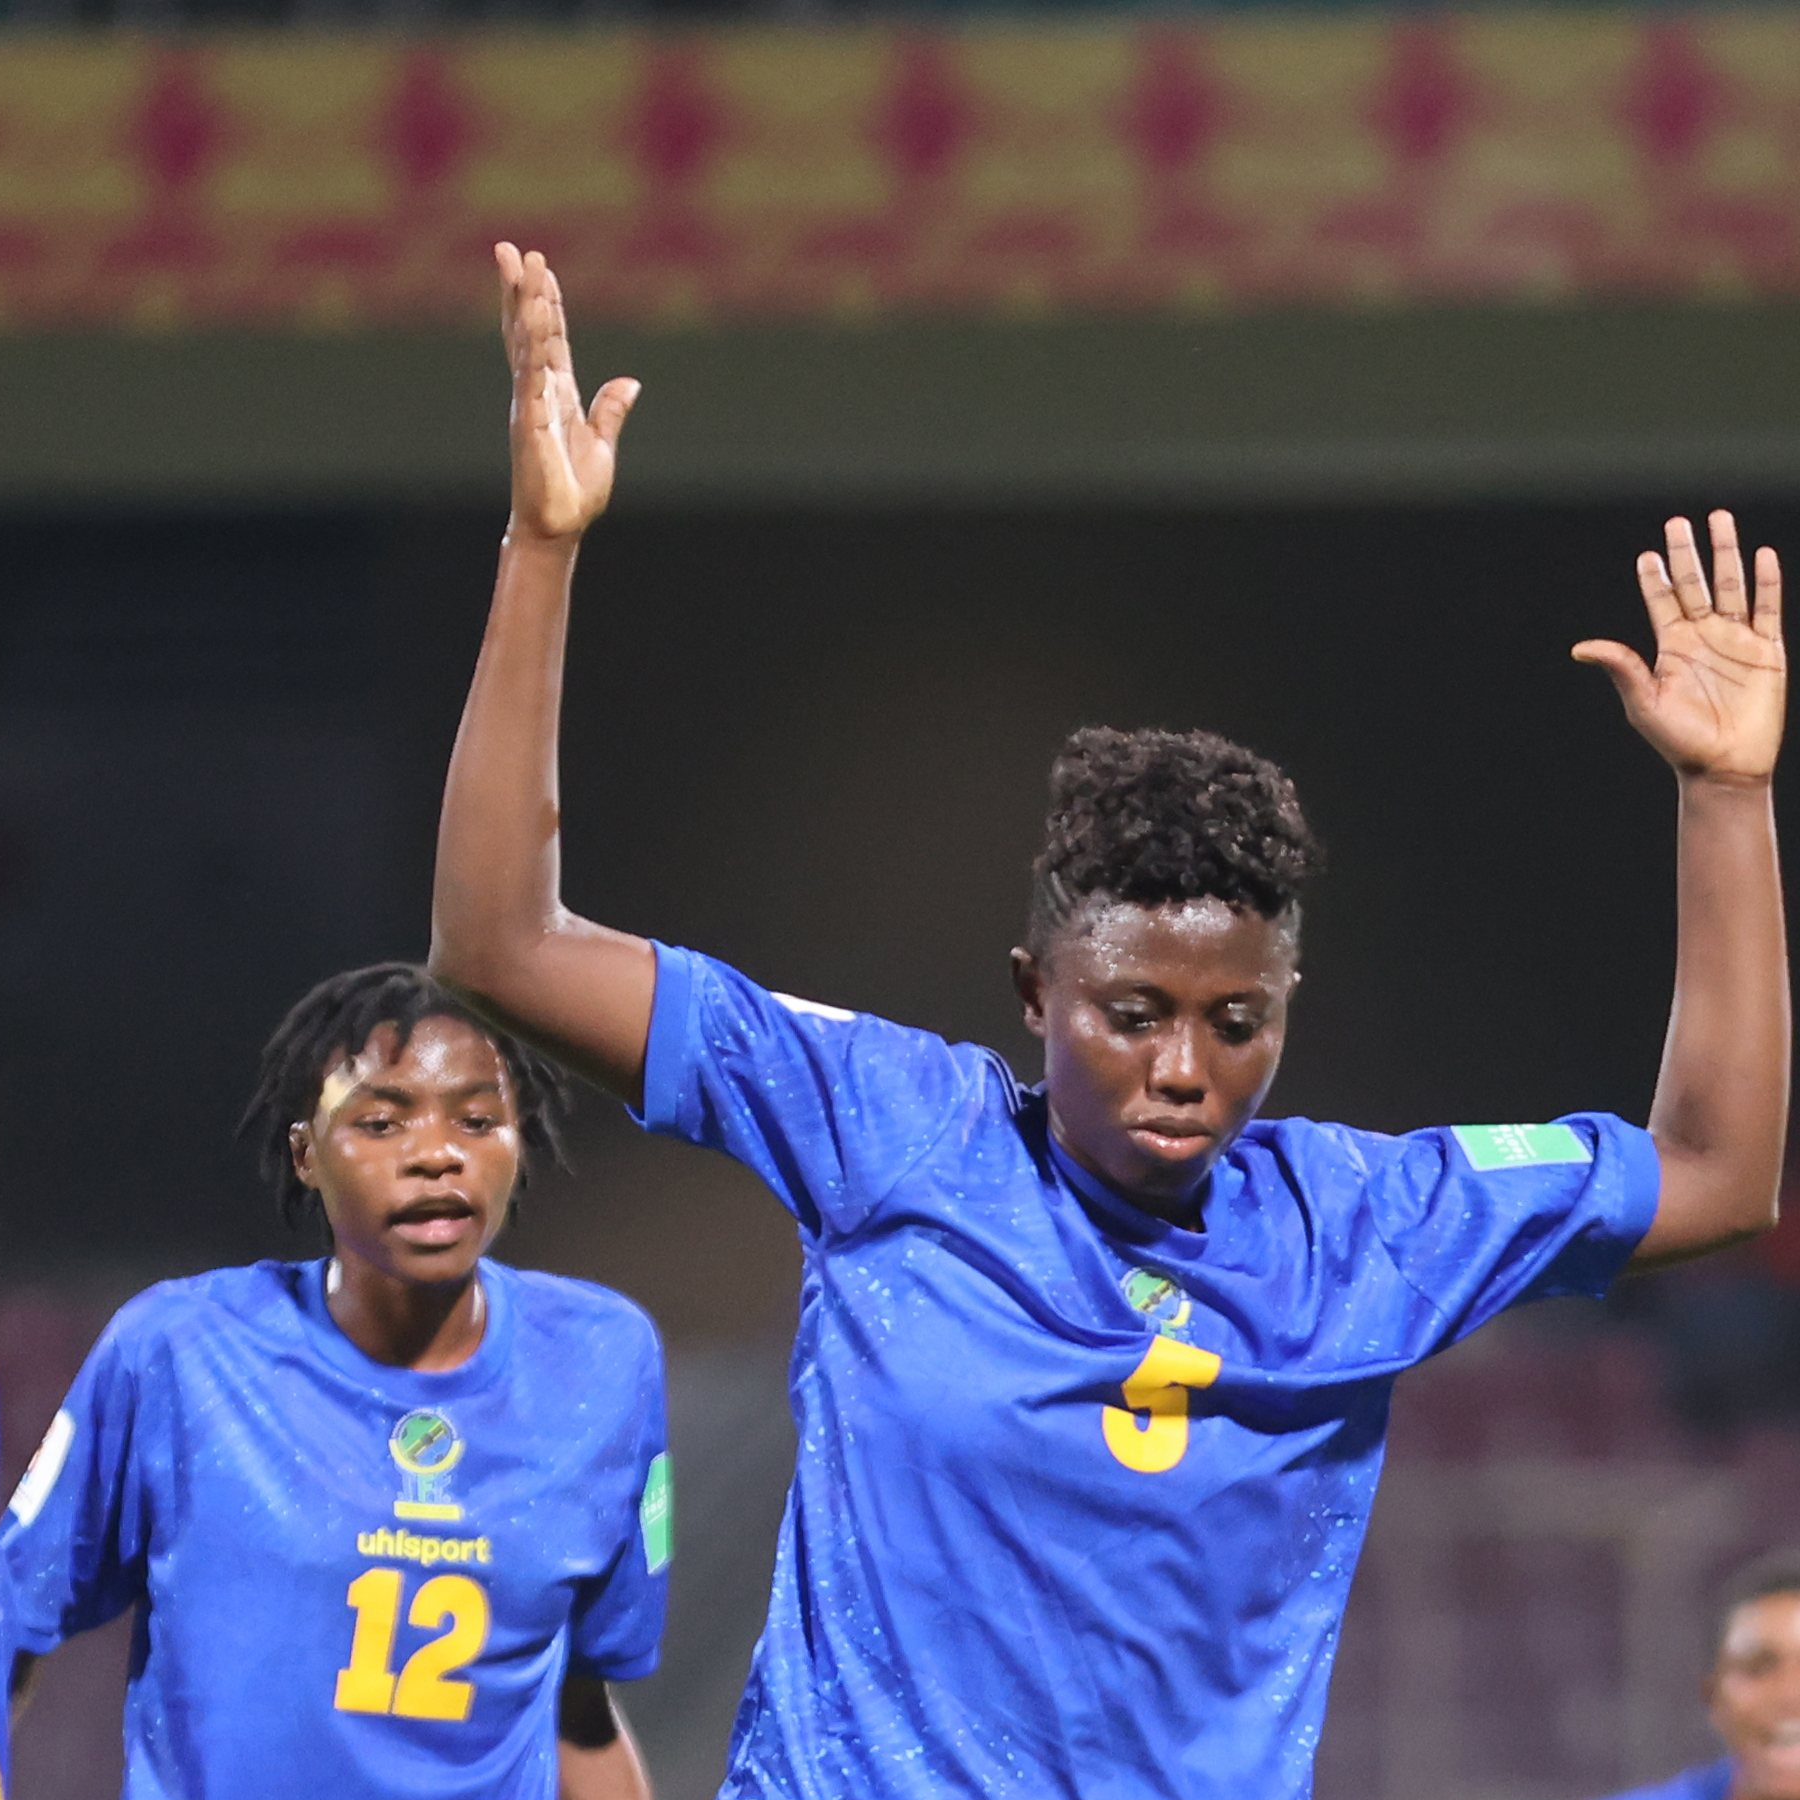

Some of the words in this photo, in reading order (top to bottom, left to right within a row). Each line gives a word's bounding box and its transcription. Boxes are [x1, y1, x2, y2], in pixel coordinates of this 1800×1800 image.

[1102, 1335, 1222, 1473] 5
[357, 1528, 490, 1564] uhlsport
[334, 1567, 490, 1721] 12
